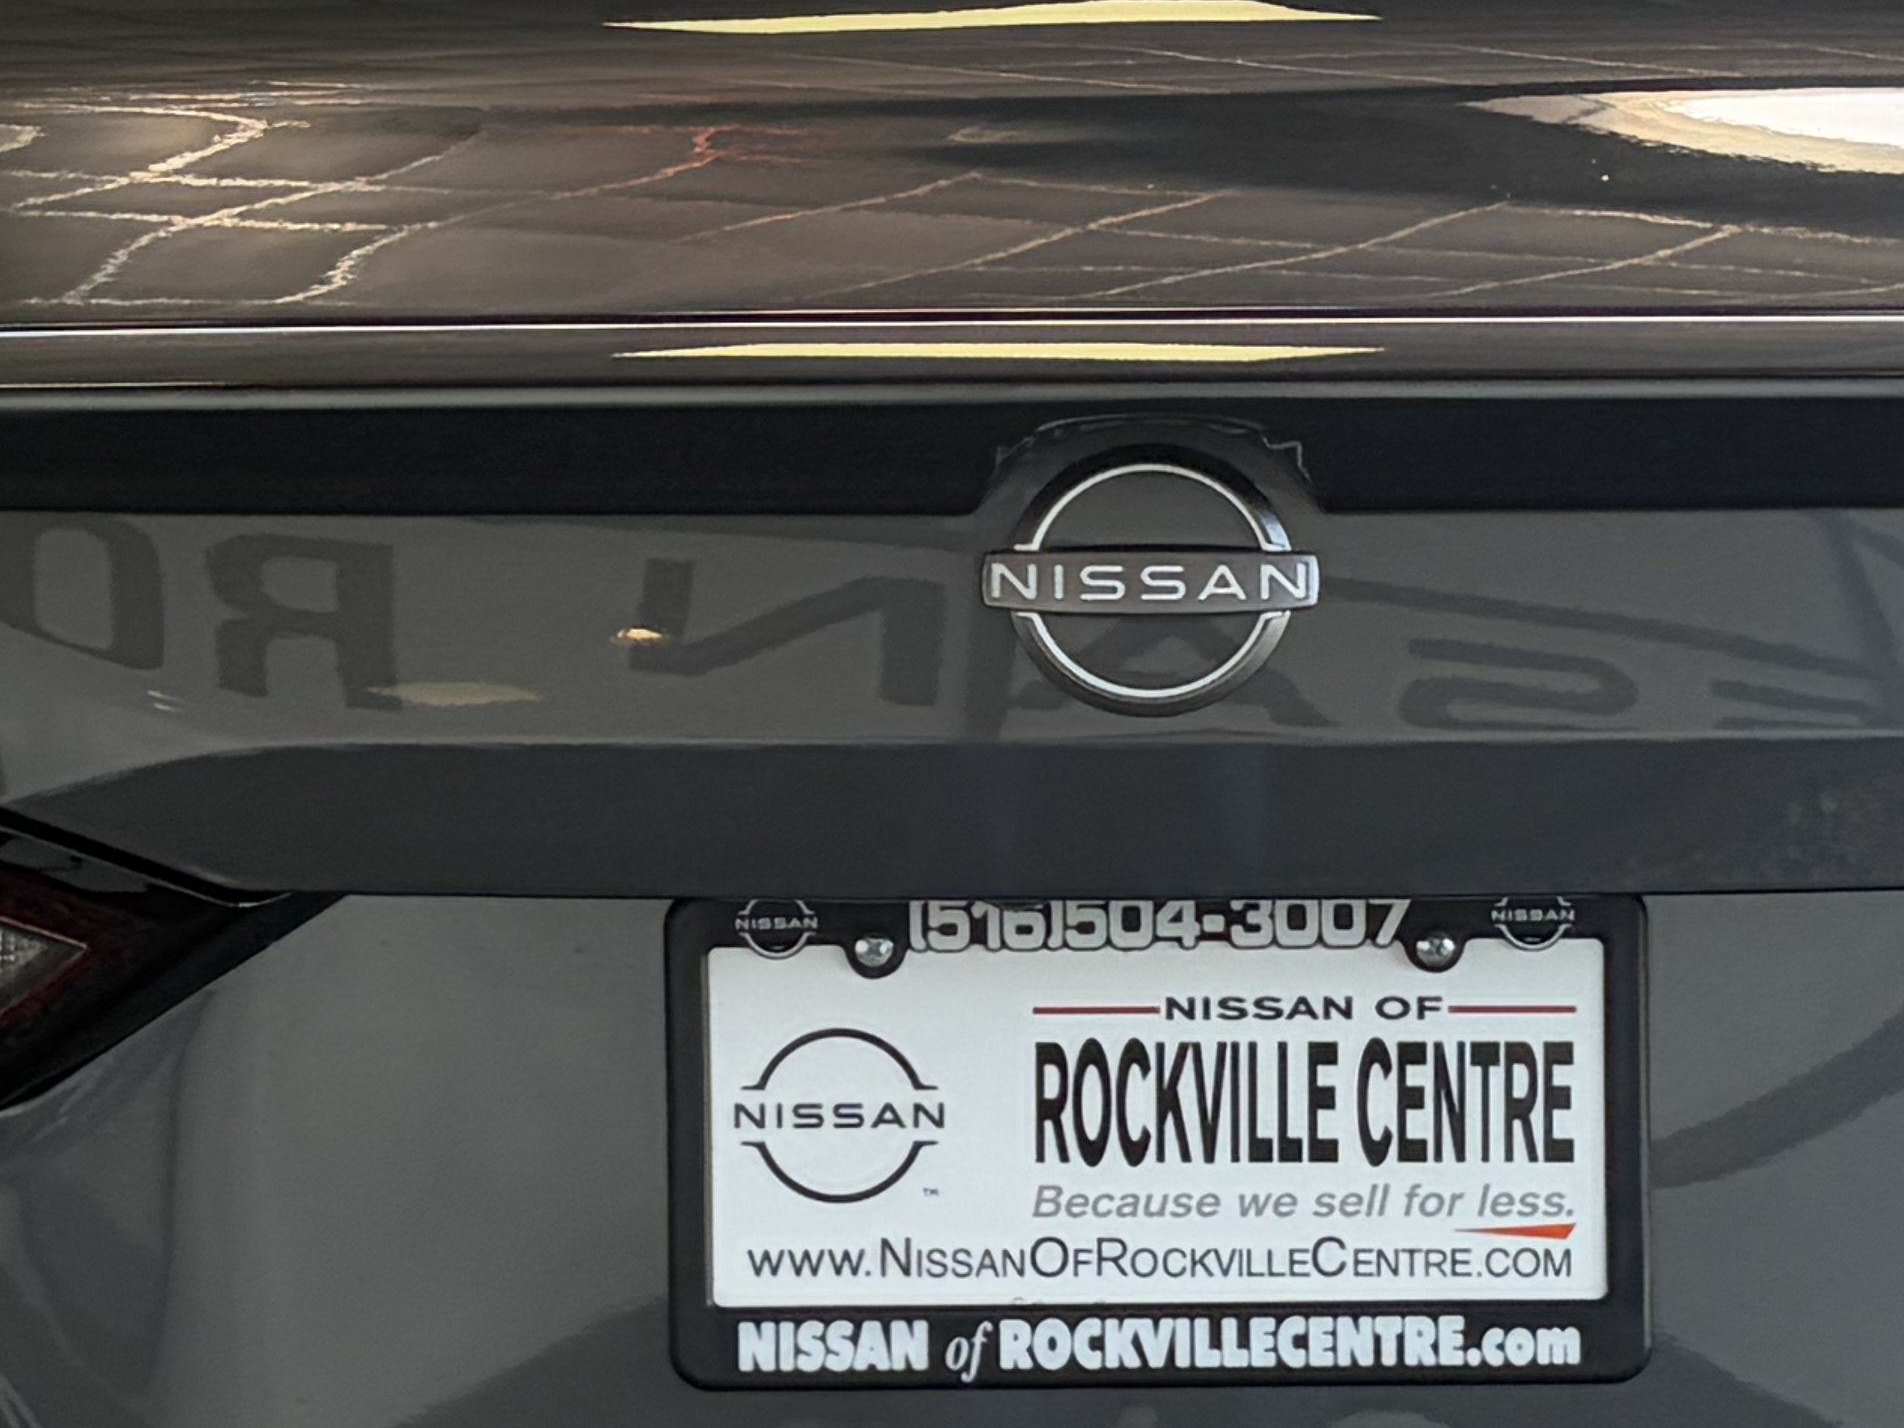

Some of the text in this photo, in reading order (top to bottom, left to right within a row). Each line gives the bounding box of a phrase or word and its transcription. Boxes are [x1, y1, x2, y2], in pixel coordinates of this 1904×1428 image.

[990, 562, 1309, 602] NISSAN
[734, 915, 819, 931] NISSAN
[908, 898, 1412, 953] (516)504-3007
[1490, 908, 1576, 922] NISSAN
[1164, 995, 1444, 1021] NISSAN OF
[733, 1102, 946, 1130] NISSAN
[1033, 1037, 1576, 1168] ROCKVILLE CENTRE
[1031, 1183, 1576, 1219] Because we sell for less.
[737, 1314, 1582, 1384] NISSAN of ROCKVILLECENTRE.com
